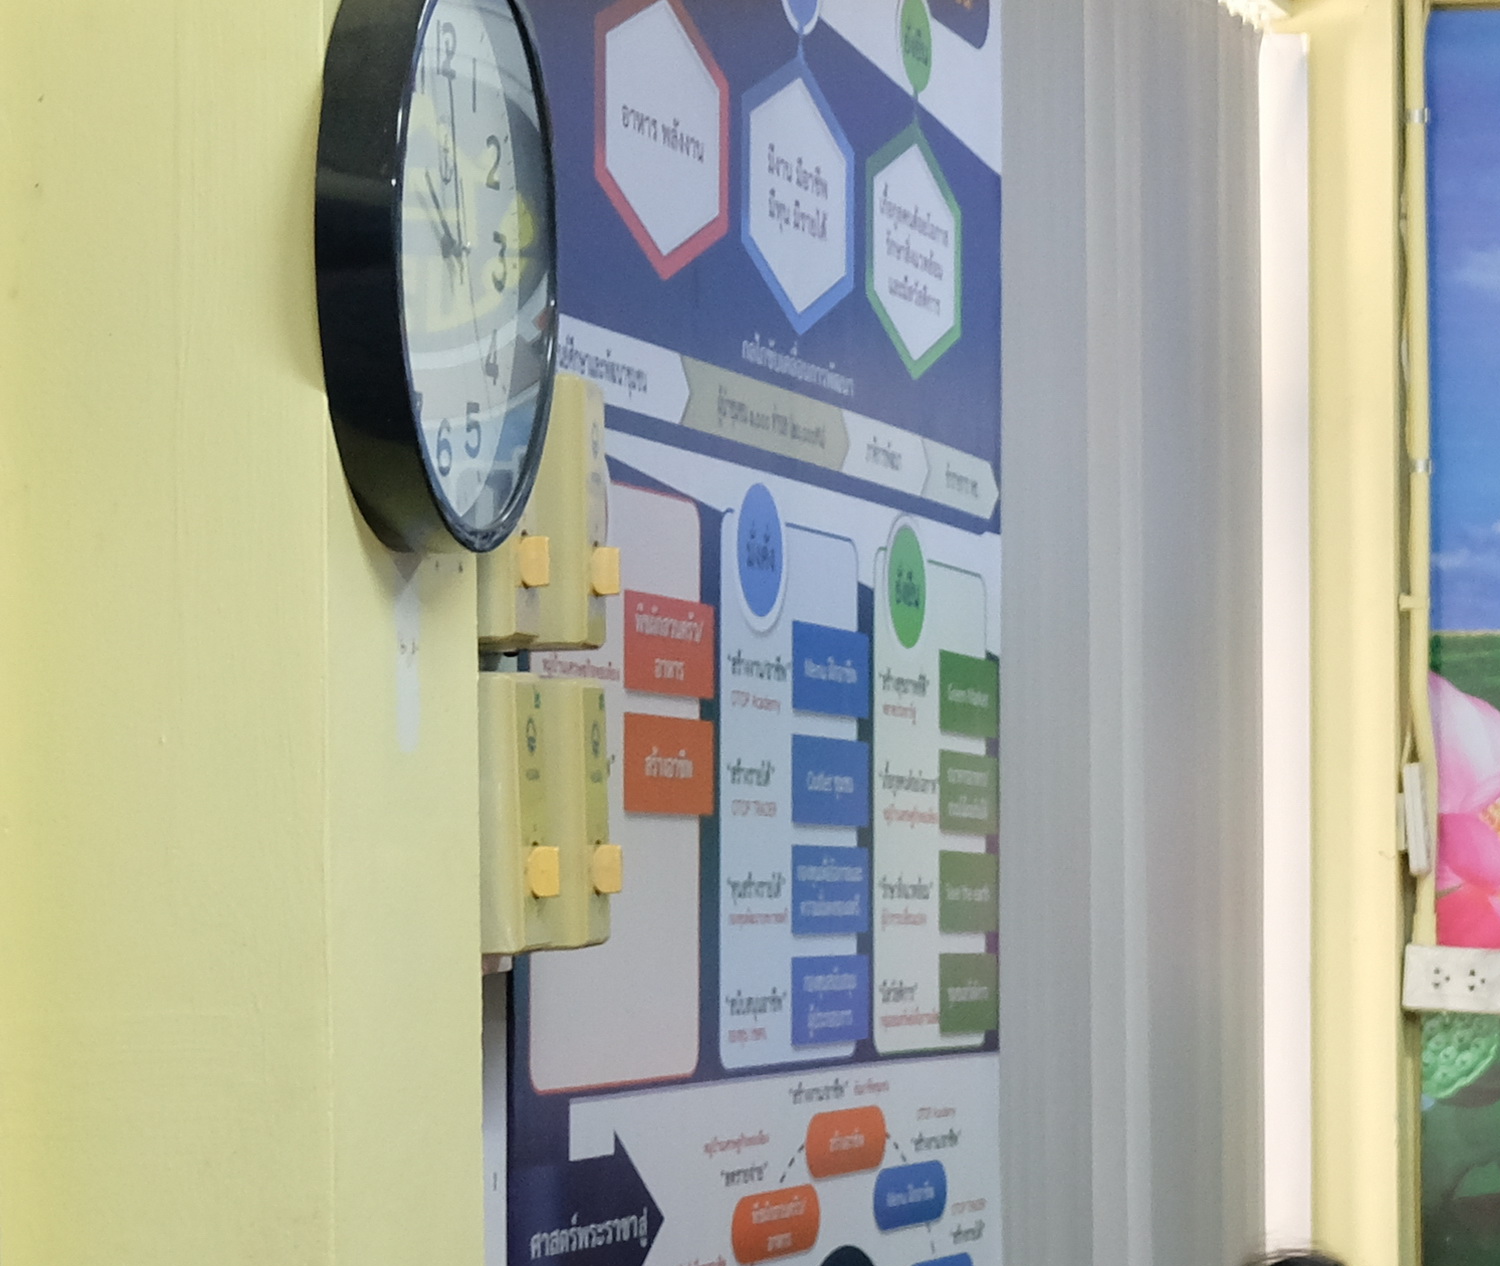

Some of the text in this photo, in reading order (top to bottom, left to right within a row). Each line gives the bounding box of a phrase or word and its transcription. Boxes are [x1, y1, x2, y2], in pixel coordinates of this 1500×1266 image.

[485, 134, 501, 191] 2
[621, 105, 704, 164] อาหาร พลังงาน
[493, 231, 507, 292] 3
[485, 328, 500, 387] 4
[436, 417, 452, 478] 6
[465, 401, 482, 459] 5
[530, 1206, 648, 1260] ศาสตร์พระราชาสู่
